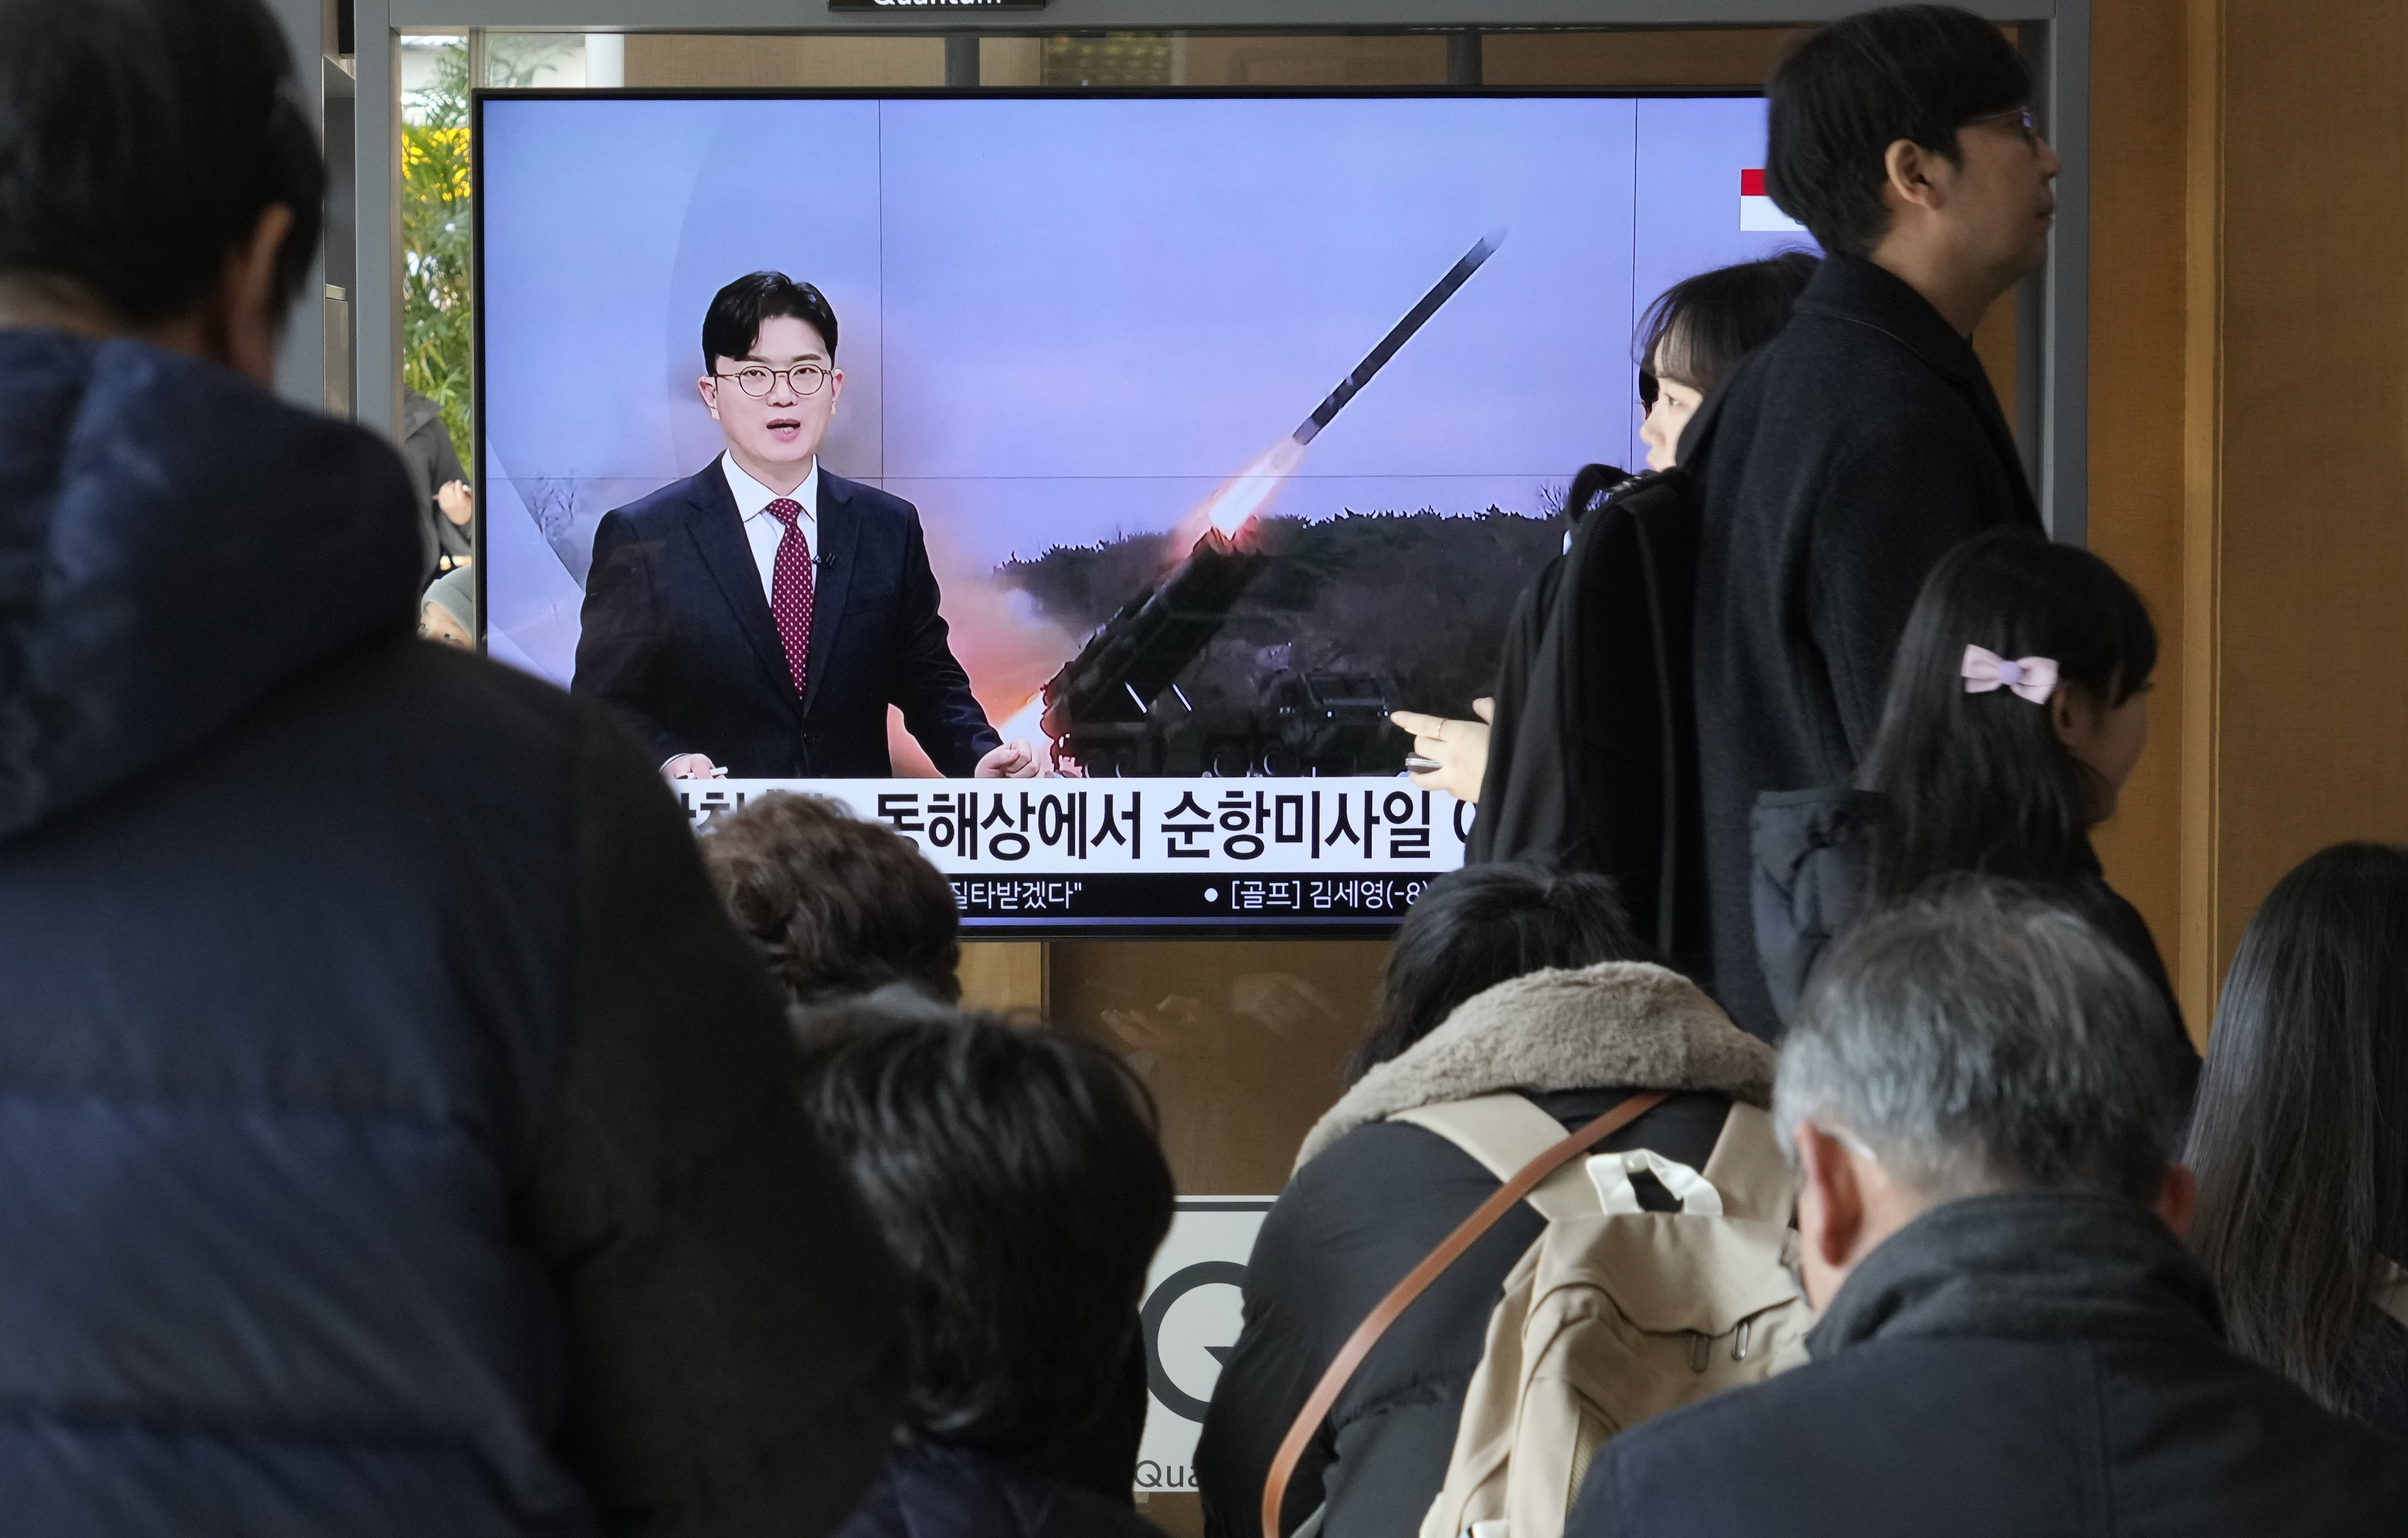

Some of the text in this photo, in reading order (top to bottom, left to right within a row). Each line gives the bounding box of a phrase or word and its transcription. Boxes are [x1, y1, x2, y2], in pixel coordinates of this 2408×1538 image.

[878, 791, 1141, 860] 동해상에서
[1161, 791, 1431, 860] 순항미사일
[1231, 880, 1428, 909] [골프] 김세영(-8
